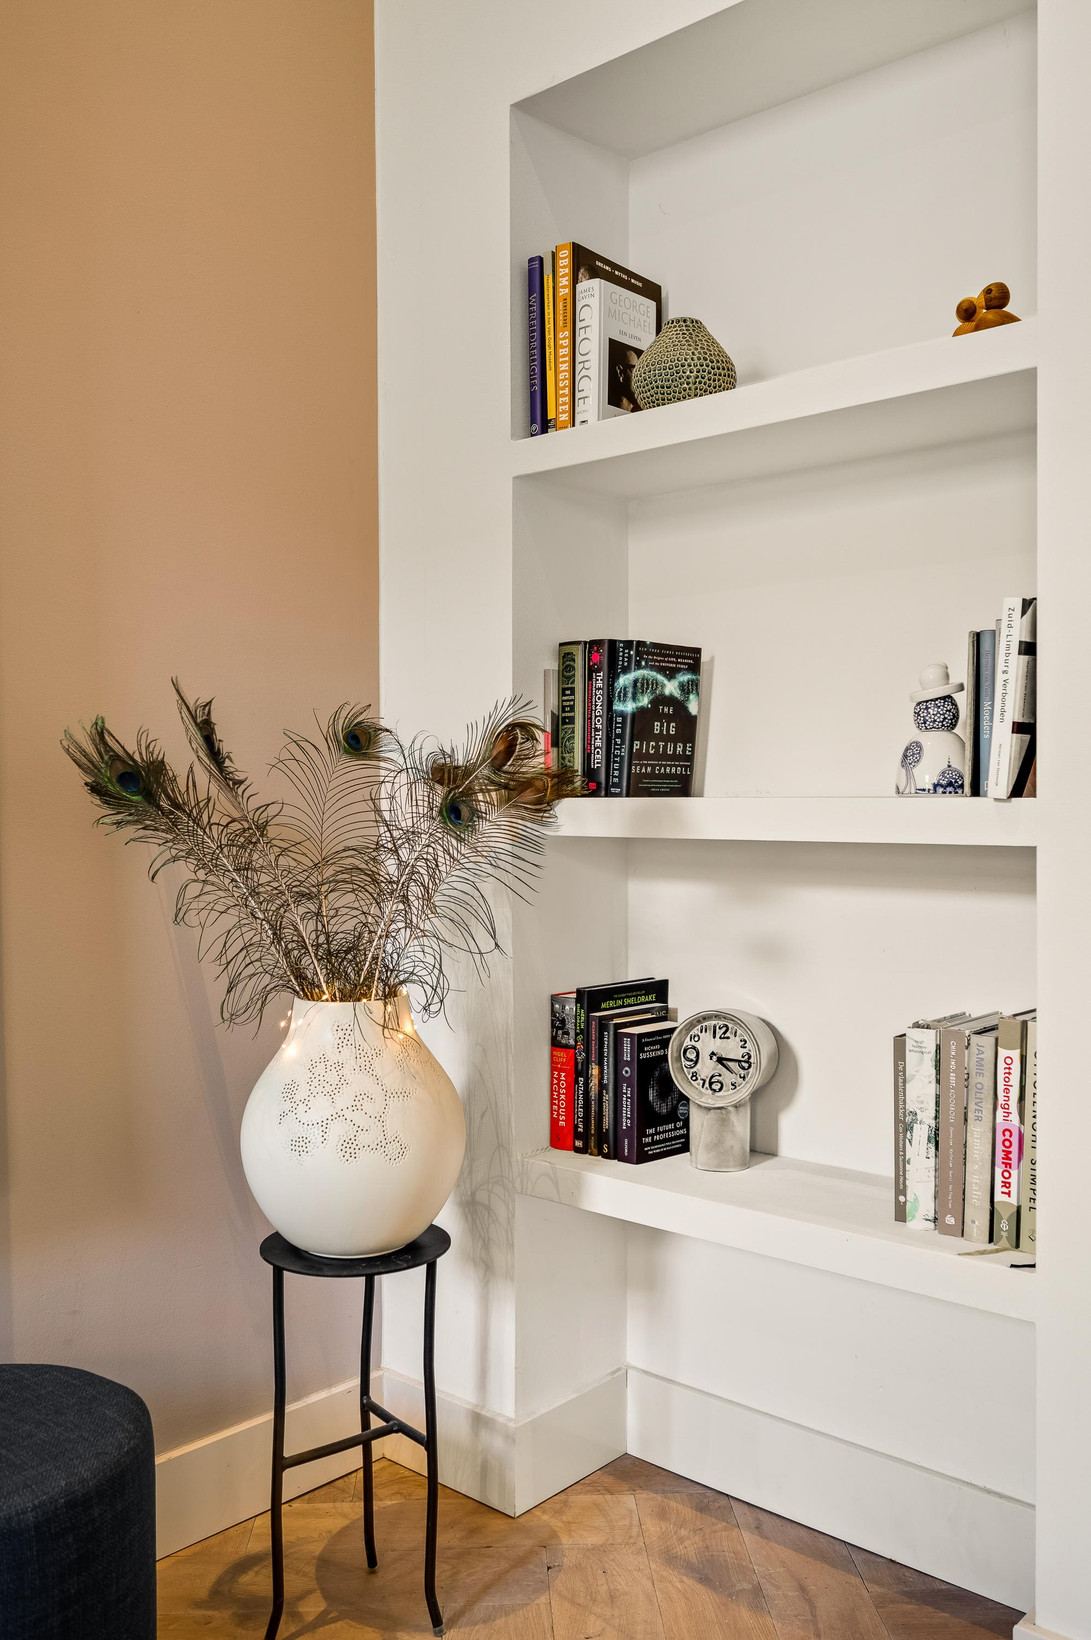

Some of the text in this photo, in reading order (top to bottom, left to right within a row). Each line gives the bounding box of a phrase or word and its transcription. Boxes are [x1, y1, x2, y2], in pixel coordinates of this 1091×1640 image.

[559, 250, 569, 296] OBAMA
[578, 293, 595, 302] GAVIN
[610, 292, 651, 318] GEORGE
[608, 306, 653, 335] MICHAEL
[528, 293, 538, 392] WERELDRELIGIES
[618, 329, 642, 342] EEN LEVEN
[577, 304, 593, 407] GEORGE
[559, 331, 569, 421] SPRINGSTEEN
[999, 607, 1015, 723] Zuid-Limburg Verbonden
[659, 706, 673, 714] THE
[596, 717, 602, 730] OF
[654, 720, 676, 734] BIG
[983, 701, 992, 739] Moeders
[633, 741, 692, 755] PICTURE
[594, 748, 602, 769] CELL
[613, 738, 621, 783] PICTURE
[632, 766, 651, 774] SEAN
[601, 999, 623, 1009] MERLIN
[624, 994, 656, 1005] SHELDRAKE
[700, 1024, 708, 1033] 11
[712, 1024, 730, 1039] 12
[734, 1029, 738, 1037] 1
[690, 1034, 700, 1042] 10
[740, 1038, 747, 1048] 2
[640, 1050, 664, 1059] SUSSKIND
[683, 1045, 700, 1069] 9
[738, 1052, 752, 1070] 3
[898, 1061, 905, 1071] De
[690, 1071, 698, 1082] 8
[700, 1078, 706, 1088] 7
[708, 1072, 724, 1092] 6
[739, 1073, 746, 1081] 4
[974, 1043, 984, 1122] JAMIE OLIVER
[730, 1081, 737, 1090] 5
[1000, 1056, 1014, 1122] Ottolenghi
[627, 1119, 631, 1127] OF
[657, 1123, 674, 1132] FUTURE
[654, 1128, 687, 1141] PROFESSIONS
[972, 1127, 984, 1170] jamie's
[1001, 1128, 1013, 1198] COMFORT
